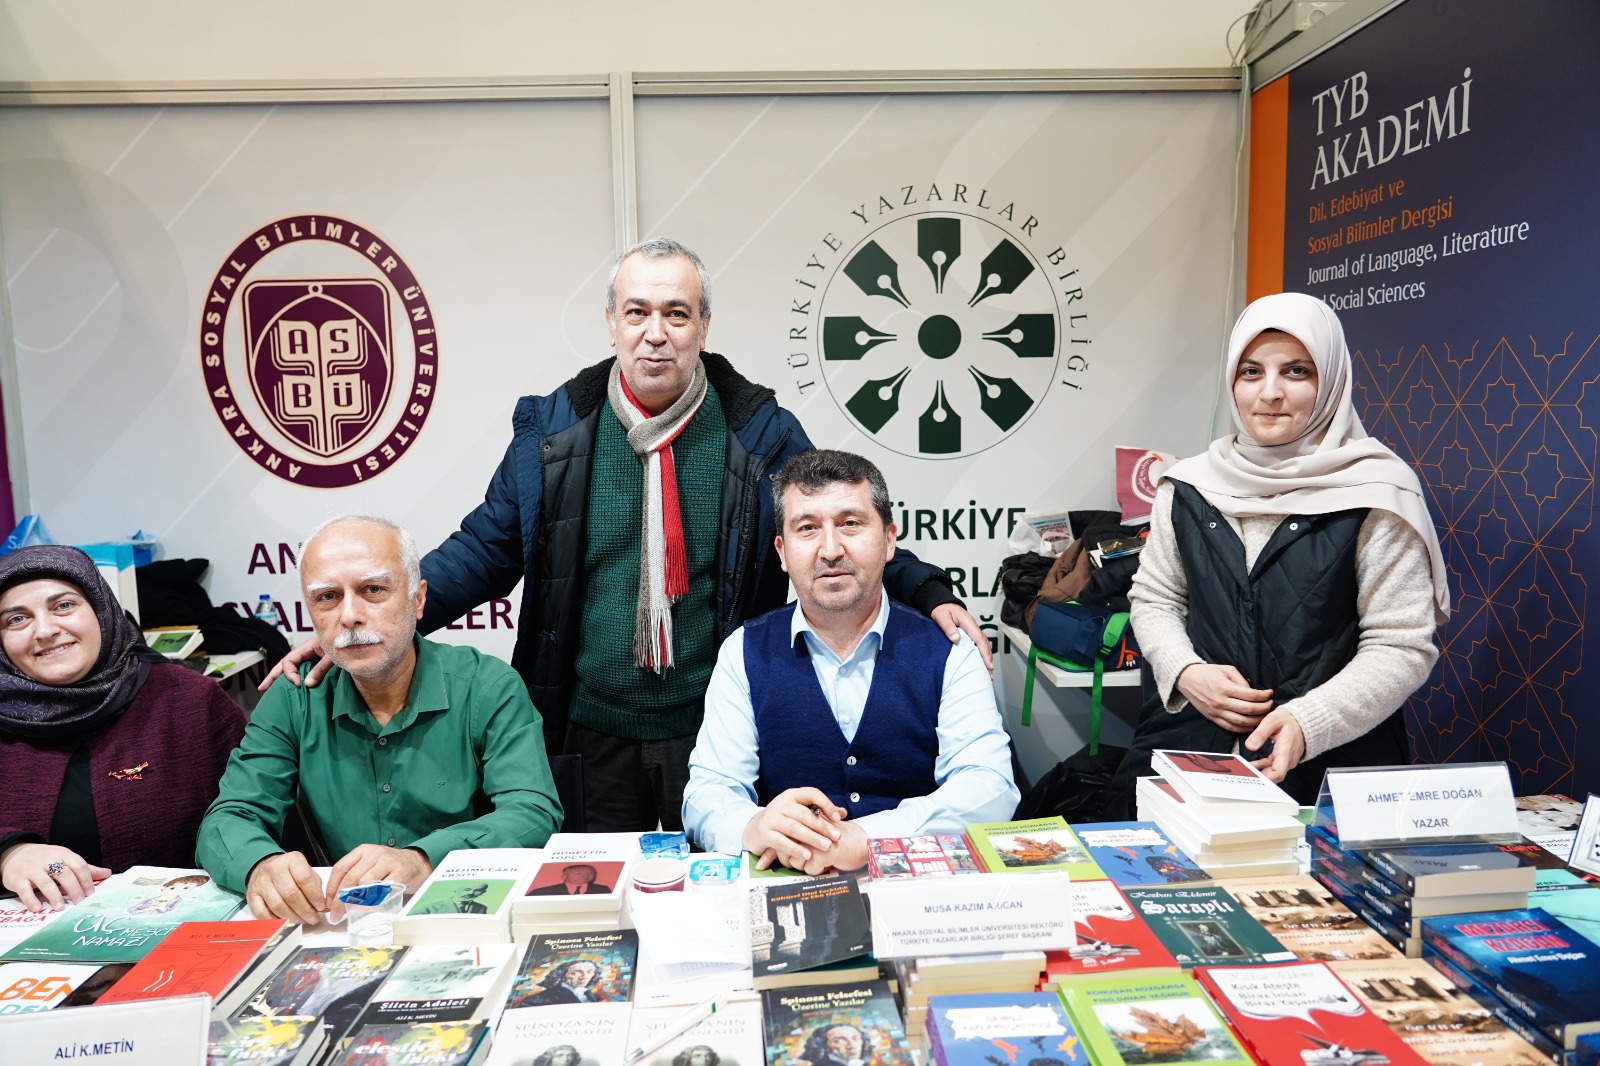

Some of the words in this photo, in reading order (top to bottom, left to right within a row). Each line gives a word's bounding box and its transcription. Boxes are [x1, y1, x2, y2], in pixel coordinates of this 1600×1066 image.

[1312, 70, 1369, 136] TYB
[1310, 66, 1473, 190] AKADEMİ
[1331, 183, 1383, 218] Edebiyat
[1389, 179, 1405, 198] ve
[1307, 232, 1343, 255] Sosyal
[1346, 215, 1398, 245] Bilimler
[1401, 196, 1453, 229] Dergisi
[254, 217, 398, 273] BİLİMLER
[1307, 258, 1348, 285] Journal
[1352, 255, 1364, 277] of
[1368, 242, 1437, 272] Language,
[1442, 221, 1530, 257] Literature
[787, 231, 843, 395] TÜRKİYE
[850, 182, 1040, 238] YAZARLAR
[1045, 246, 1093, 391] BİRLİĞİ
[1329, 288, 1363, 311] Social
[1367, 280, 1426, 306] Sciences
[205, 259, 247, 367] SOSYAL
[351, 285, 435, 481] ÜNİVERSİTESİ
[214, 385, 302, 479] ANKARA
[888, 500, 1026, 542] ÜRKİYE
[1367, 792, 1404, 804] AHMET
[1409, 790, 1440, 801] EMRE
[1443, 787, 1482, 799] DOĞAN
[1412, 818, 1449, 829] YAZAR
[924, 903, 952, 913] MUSA
[954, 902, 984, 912] KAZIM
[1140, 899, 1234, 916] Saraylı
[544, 937, 582, 946] Spinoza
[584, 934, 622, 942] Felsefesi
[900, 936, 930, 945] TÜRKİYE
[932, 935, 969, 944] YAZARLAR
[971, 933, 996, 942] BİRLİĞİ
[998, 932, 1020, 940] ŞEREF
[1022, 931, 1052, 940] BAŞKANI
[918, 928, 946, 936] SOSYAL
[948, 925, 980, 934] BİLİMLER
[982, 922, 1029, 932] ÜNİVERSİTESİ
[1030, 921, 1064, 929] REKTÖRÜ
[380, 1002, 418, 1010] Şiirin
[421, 998, 470, 1008] Adaleti
[780, 993, 825, 1006] Spinoza
[827, 988, 872, 1000] Felsefesi
[54, 1042, 77, 1059] ALİ
